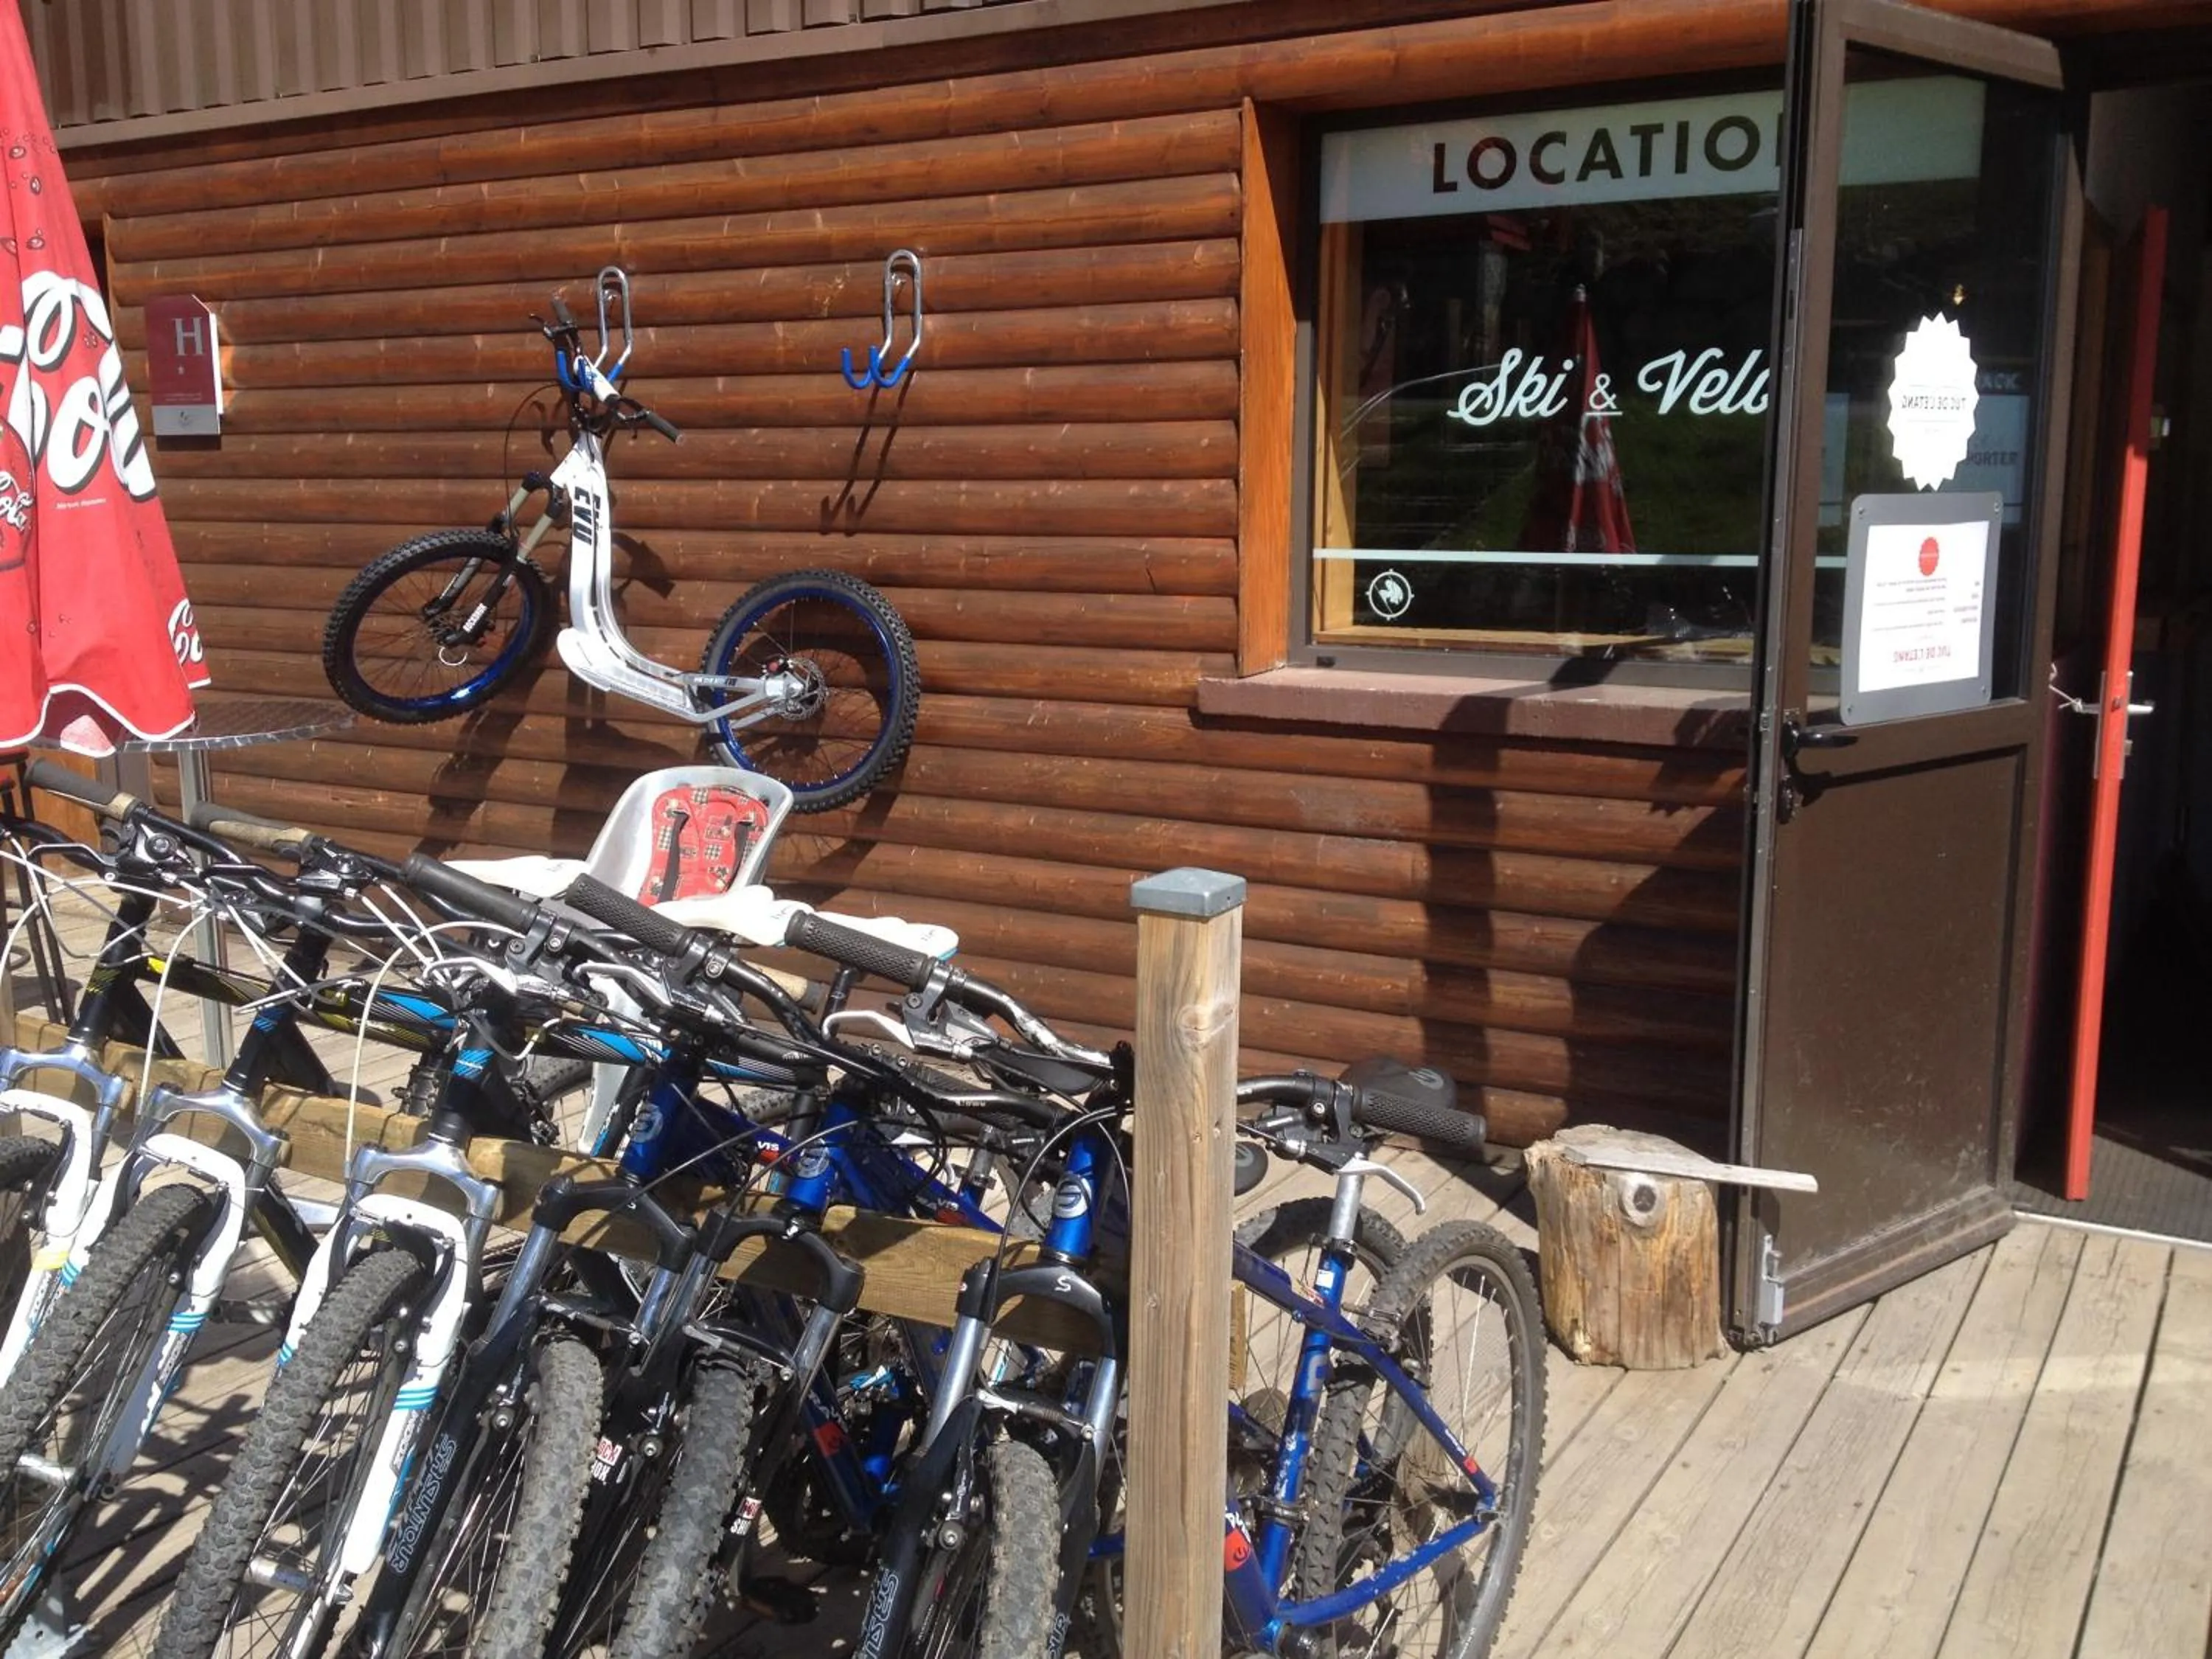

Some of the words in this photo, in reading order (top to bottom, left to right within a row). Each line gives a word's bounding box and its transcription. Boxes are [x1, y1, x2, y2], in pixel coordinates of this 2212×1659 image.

[1433, 113, 1784, 194] LOCATIO
[173, 317, 204, 357] H
[1447, 347, 1574, 426] Ski
[1589, 372, 1618, 411] &
